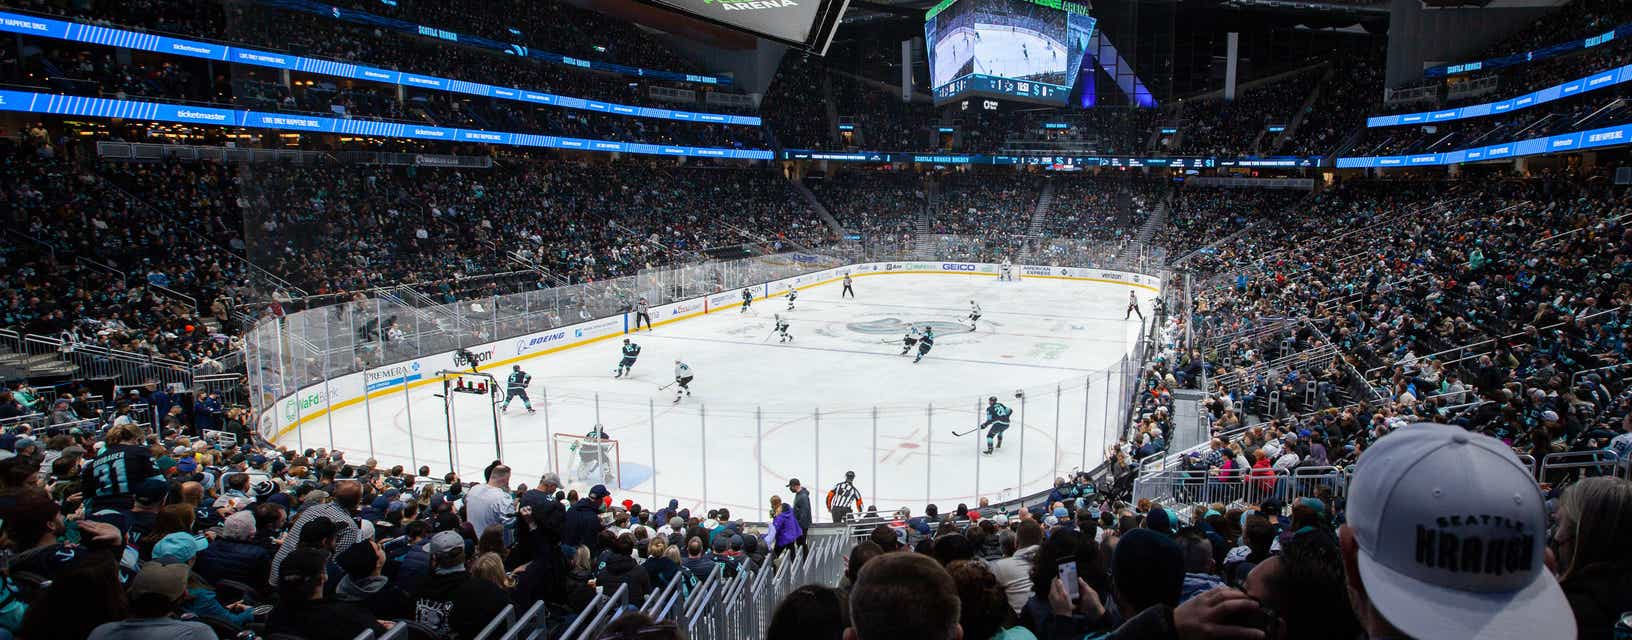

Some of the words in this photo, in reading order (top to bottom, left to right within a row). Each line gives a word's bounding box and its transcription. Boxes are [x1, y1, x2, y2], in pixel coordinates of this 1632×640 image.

[722, 0, 799, 11] ARENA
[177, 110, 226, 121] ticketmaster
[942, 263, 976, 271] GEICO
[529, 331, 565, 346] BOEING
[93, 459, 129, 496] 31
[1436, 514, 1525, 532] SEATTLE
